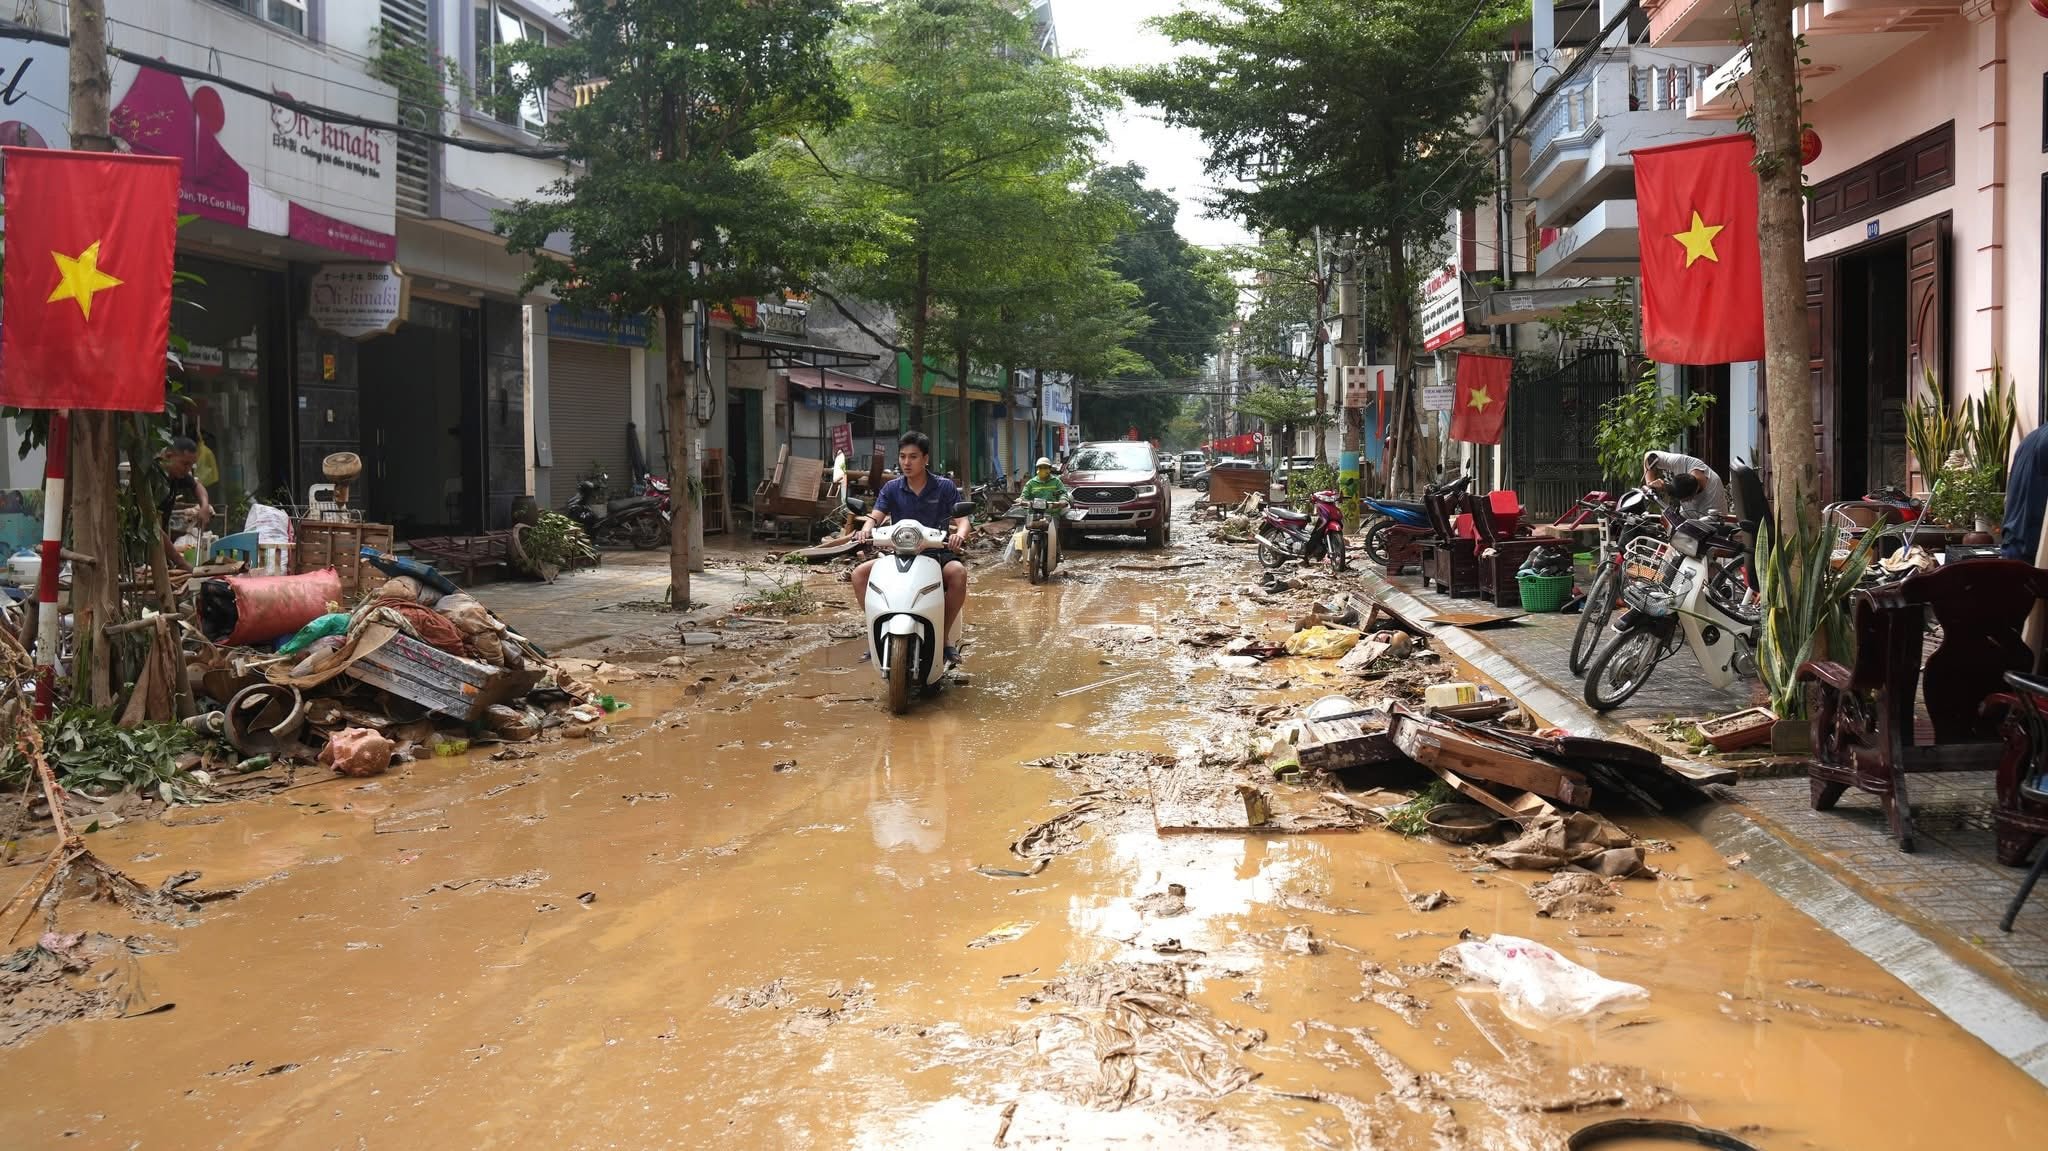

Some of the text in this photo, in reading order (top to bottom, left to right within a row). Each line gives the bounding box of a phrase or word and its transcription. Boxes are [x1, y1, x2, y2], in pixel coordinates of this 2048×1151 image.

[300, 145, 380, 178] Chúng tôi đến từ Nhật Bản
[210, 197, 225, 208] Cao
[226, 200, 246, 216] Bằng
[367, 271, 389, 281] Shop
